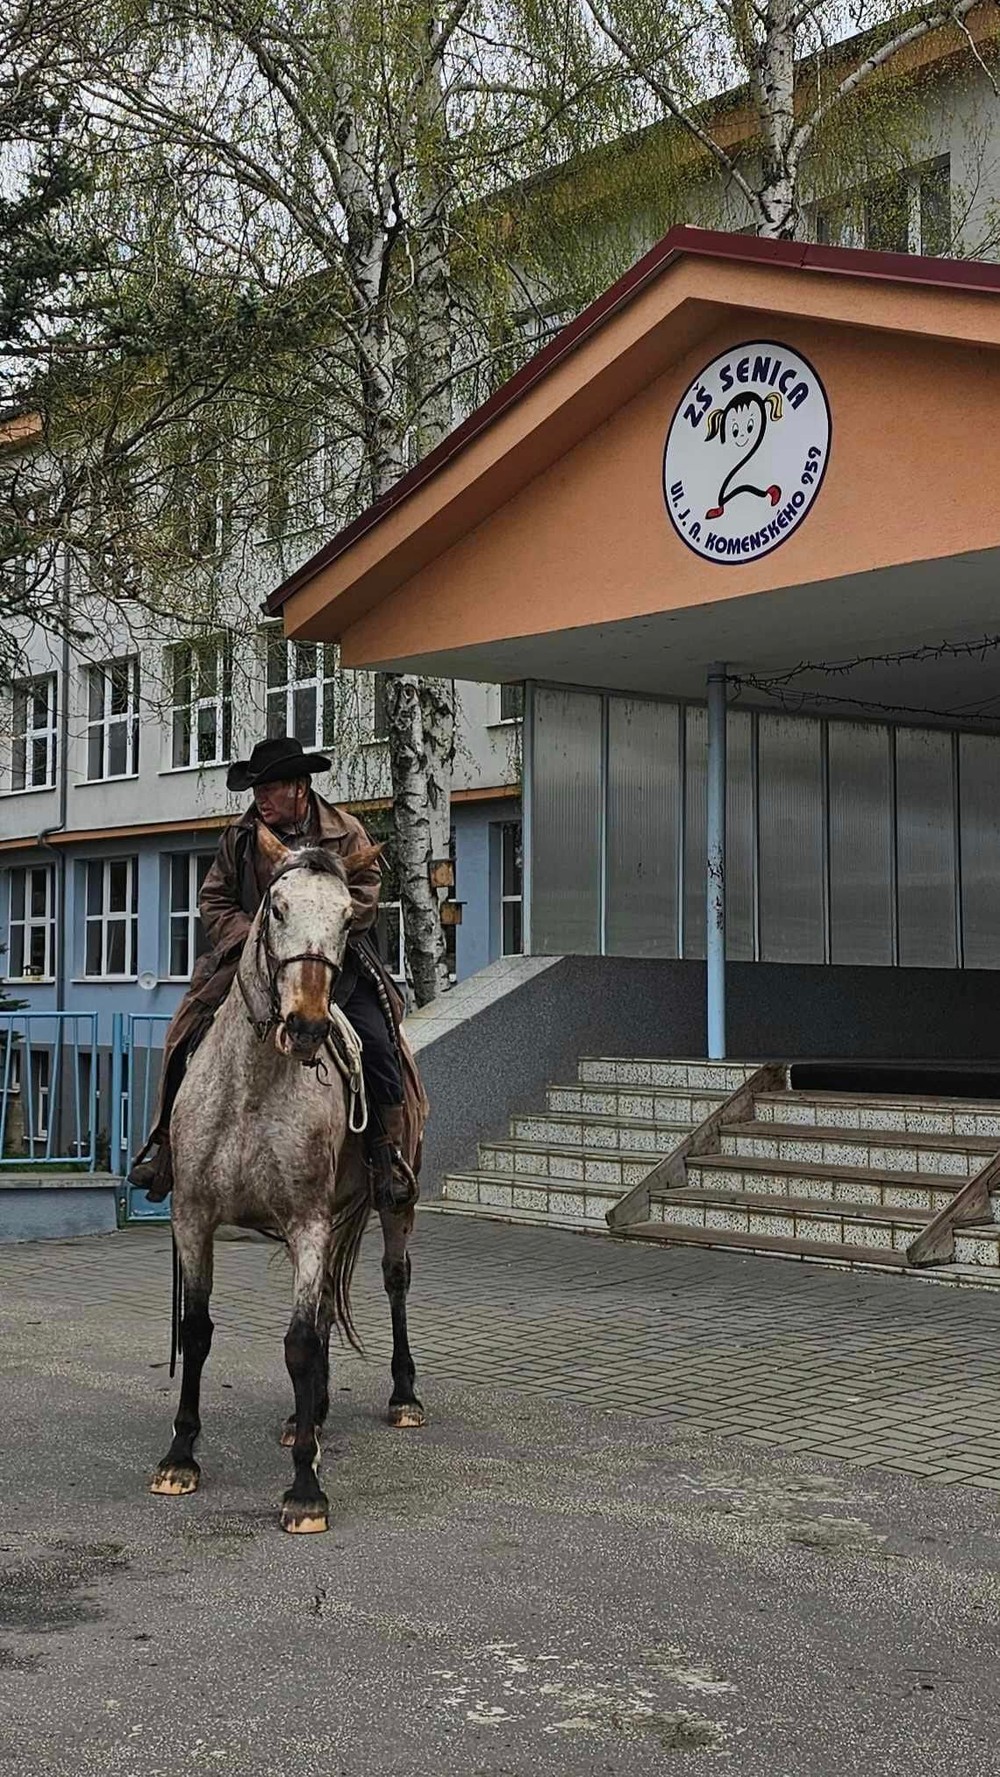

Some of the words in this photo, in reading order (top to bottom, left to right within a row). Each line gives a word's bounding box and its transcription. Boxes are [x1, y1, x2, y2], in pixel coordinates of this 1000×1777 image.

[683, 381, 713, 428] ZŠ
[719, 356, 809, 411] SENICA
[678, 508, 691, 526] J.
[688, 521, 702, 543] A.
[705, 490, 806, 556] KOMENSKÉHO
[801, 446, 822, 485] 959
